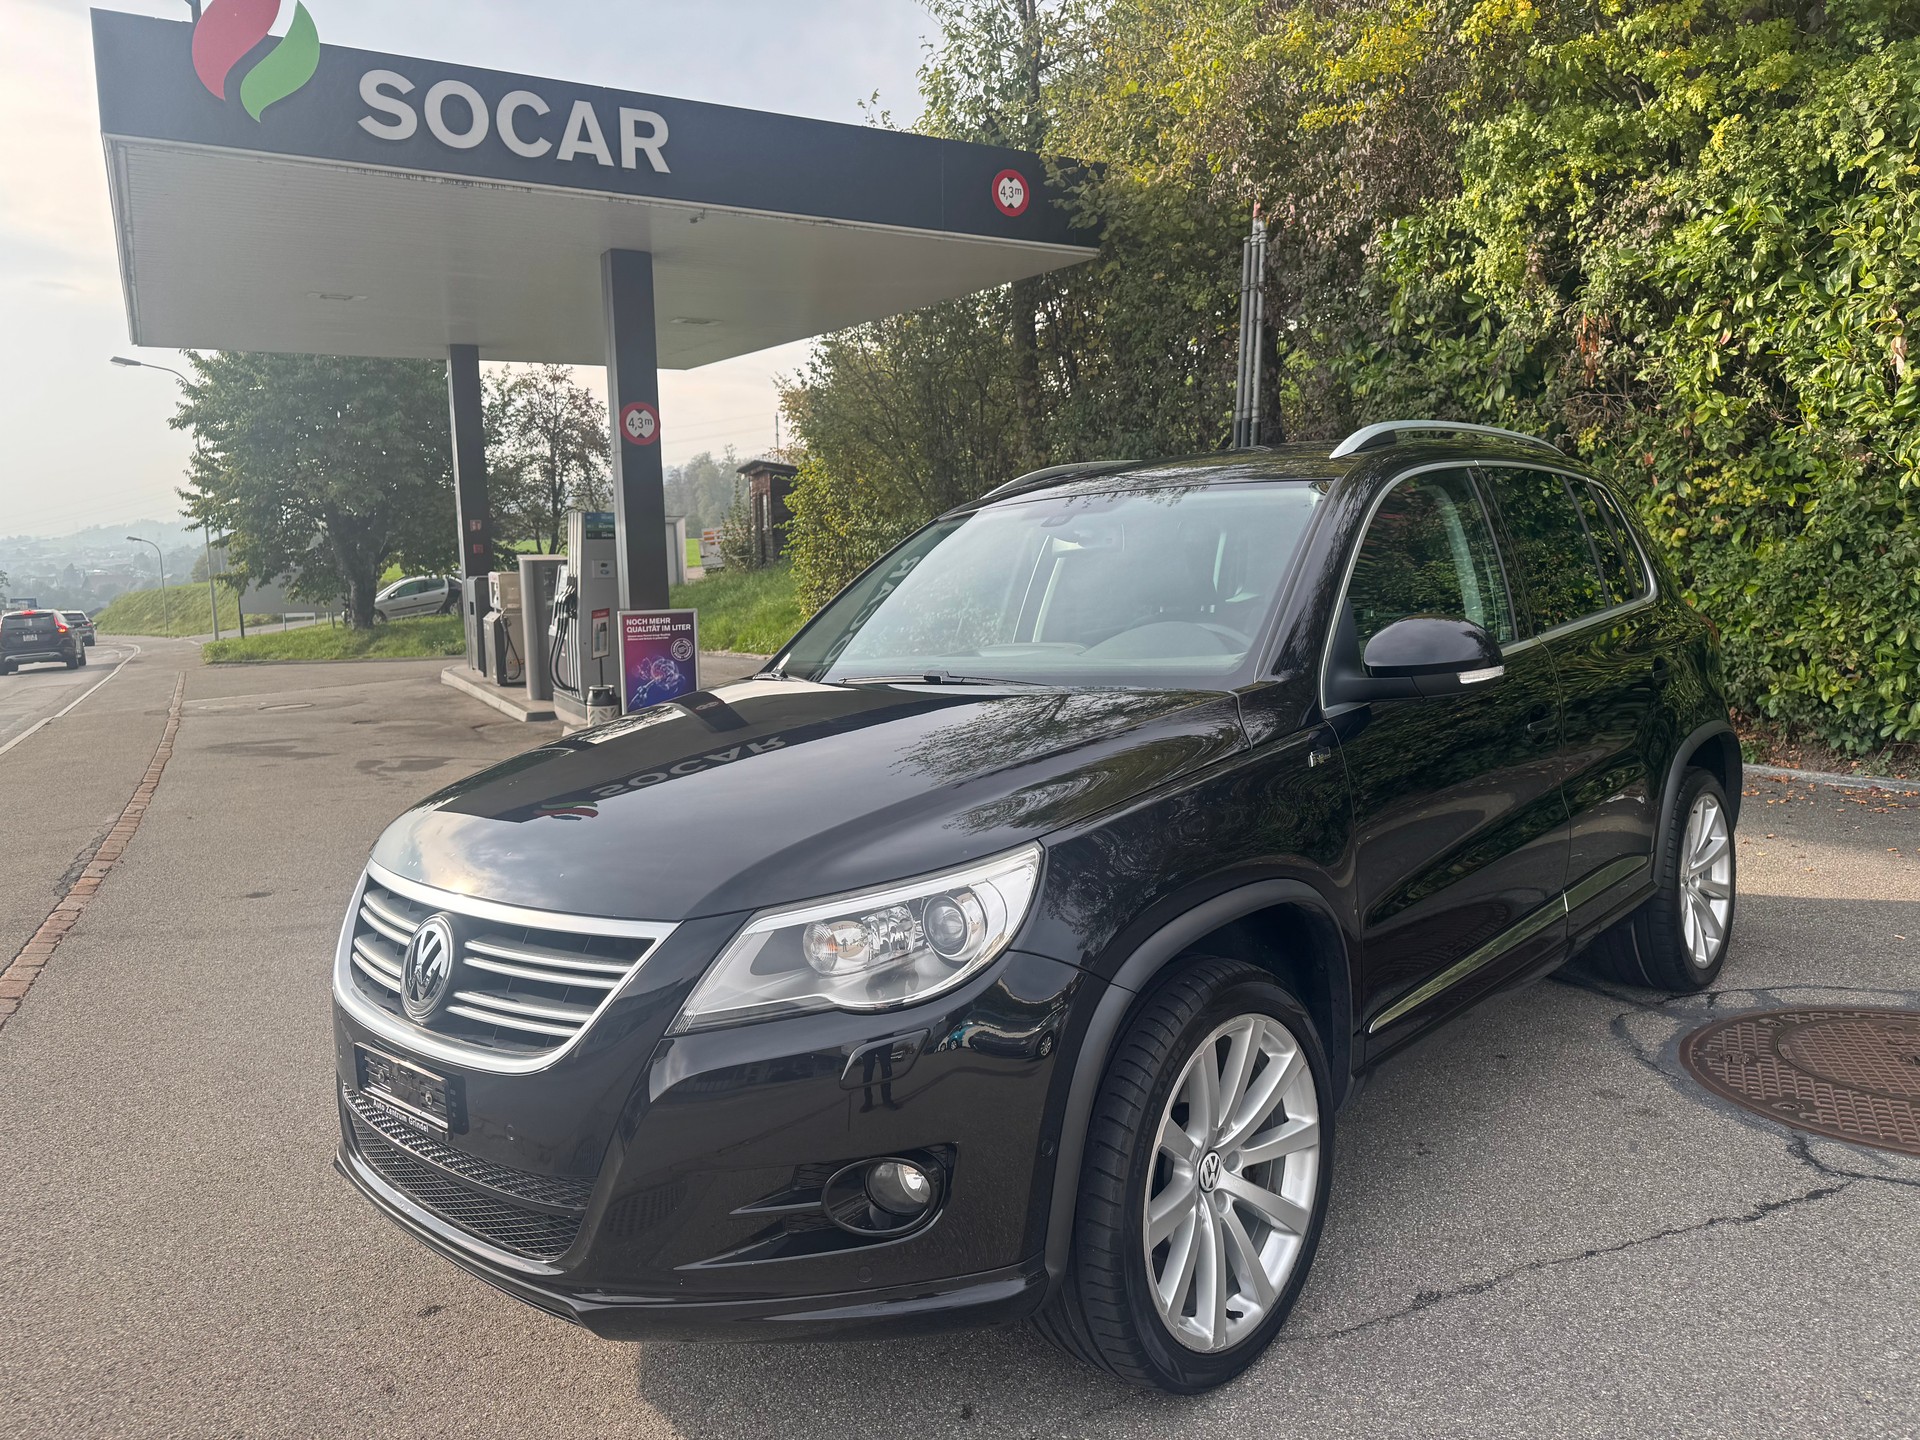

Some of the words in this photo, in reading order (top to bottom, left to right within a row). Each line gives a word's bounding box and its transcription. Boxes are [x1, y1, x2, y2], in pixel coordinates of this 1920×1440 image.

[357, 69, 671, 174] SOCAR
[626, 618, 648, 626] NOCH
[649, 617, 671, 625] MEHR
[626, 625, 661, 634] QUALITÄT
[404, 919, 451, 1012] VW
[1200, 1152, 1220, 1191] VW
